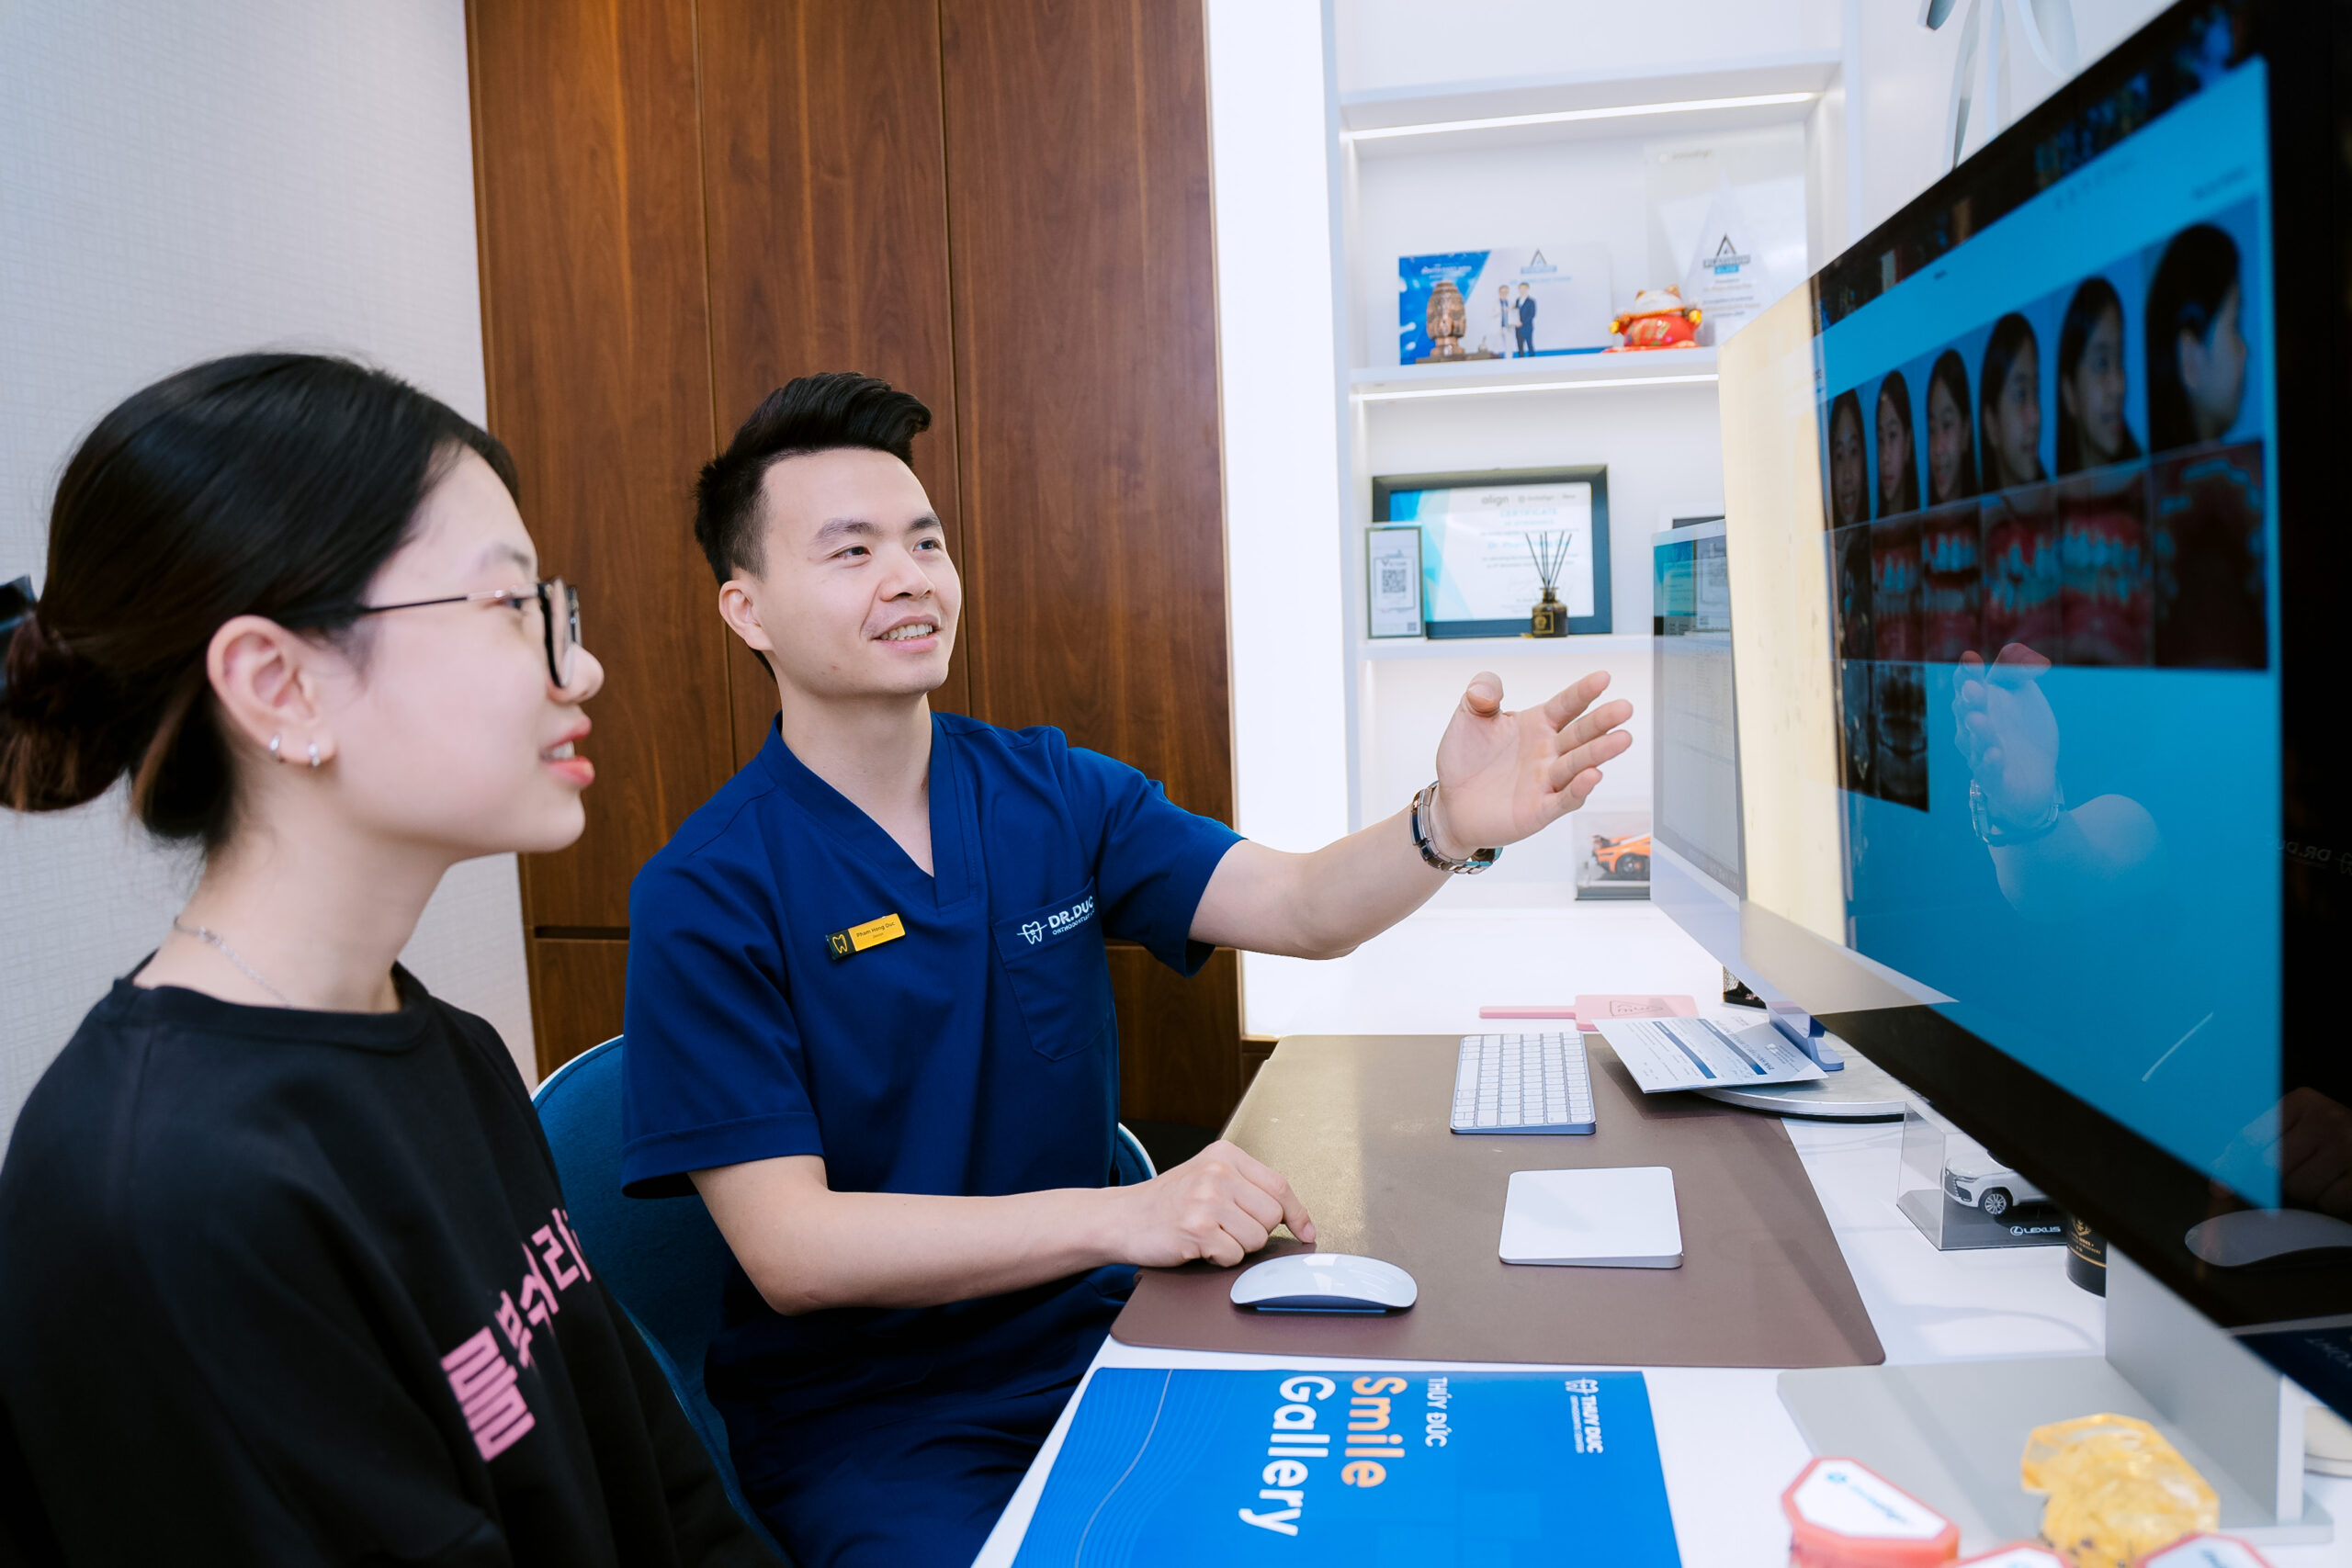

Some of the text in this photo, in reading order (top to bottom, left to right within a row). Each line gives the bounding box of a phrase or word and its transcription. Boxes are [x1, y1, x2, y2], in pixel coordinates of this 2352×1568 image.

[1481, 494, 1509, 506] align
[1238, 1375, 1337, 1536] Gallery
[1340, 1376, 1408, 1488] Smile
[1425, 1377, 1453, 1447] THÚY ĐỨC
